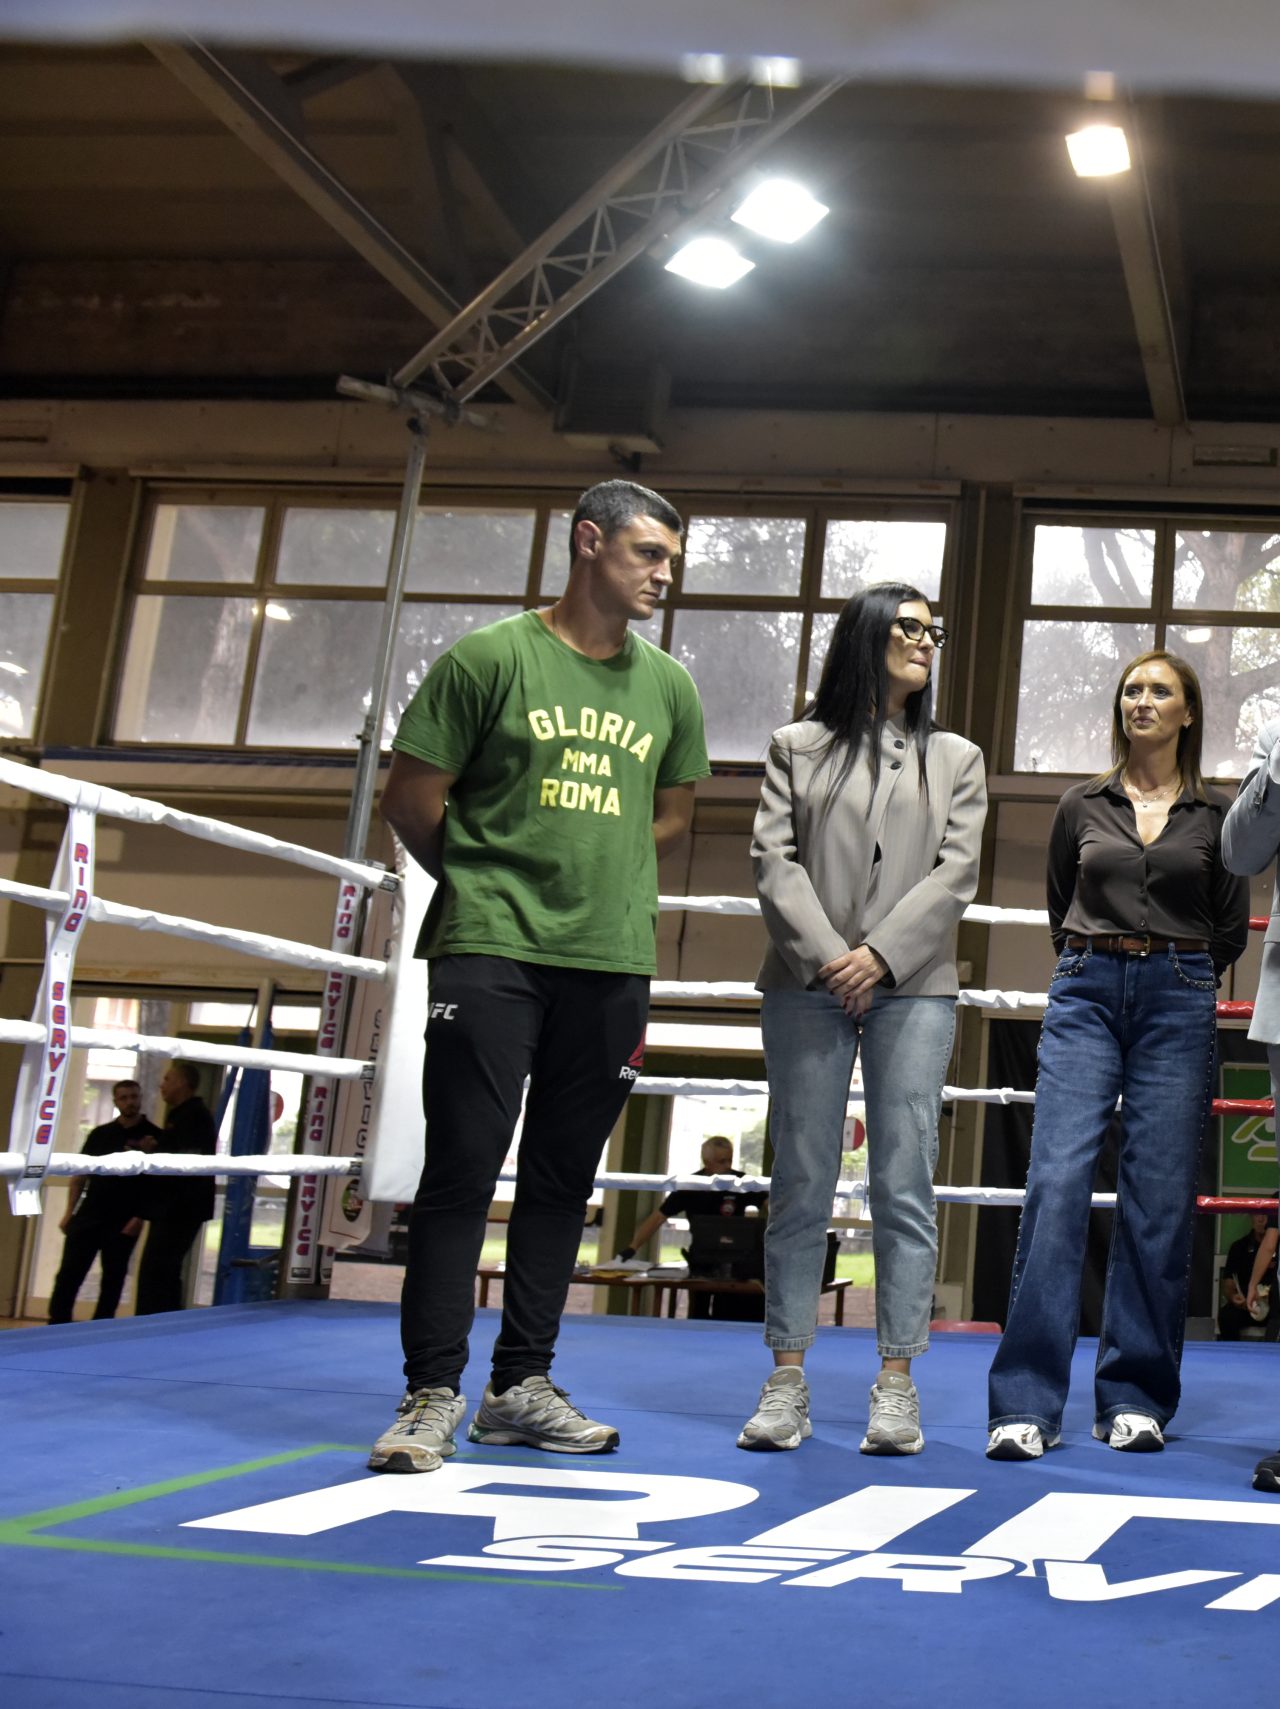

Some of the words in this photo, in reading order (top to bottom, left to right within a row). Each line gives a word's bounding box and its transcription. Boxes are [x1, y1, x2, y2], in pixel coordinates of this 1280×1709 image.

[528, 706, 653, 763] GLORIA
[561, 748, 611, 777] MMA
[540, 778, 621, 816] ROMA
[35, 981, 67, 1145] SERVICE
